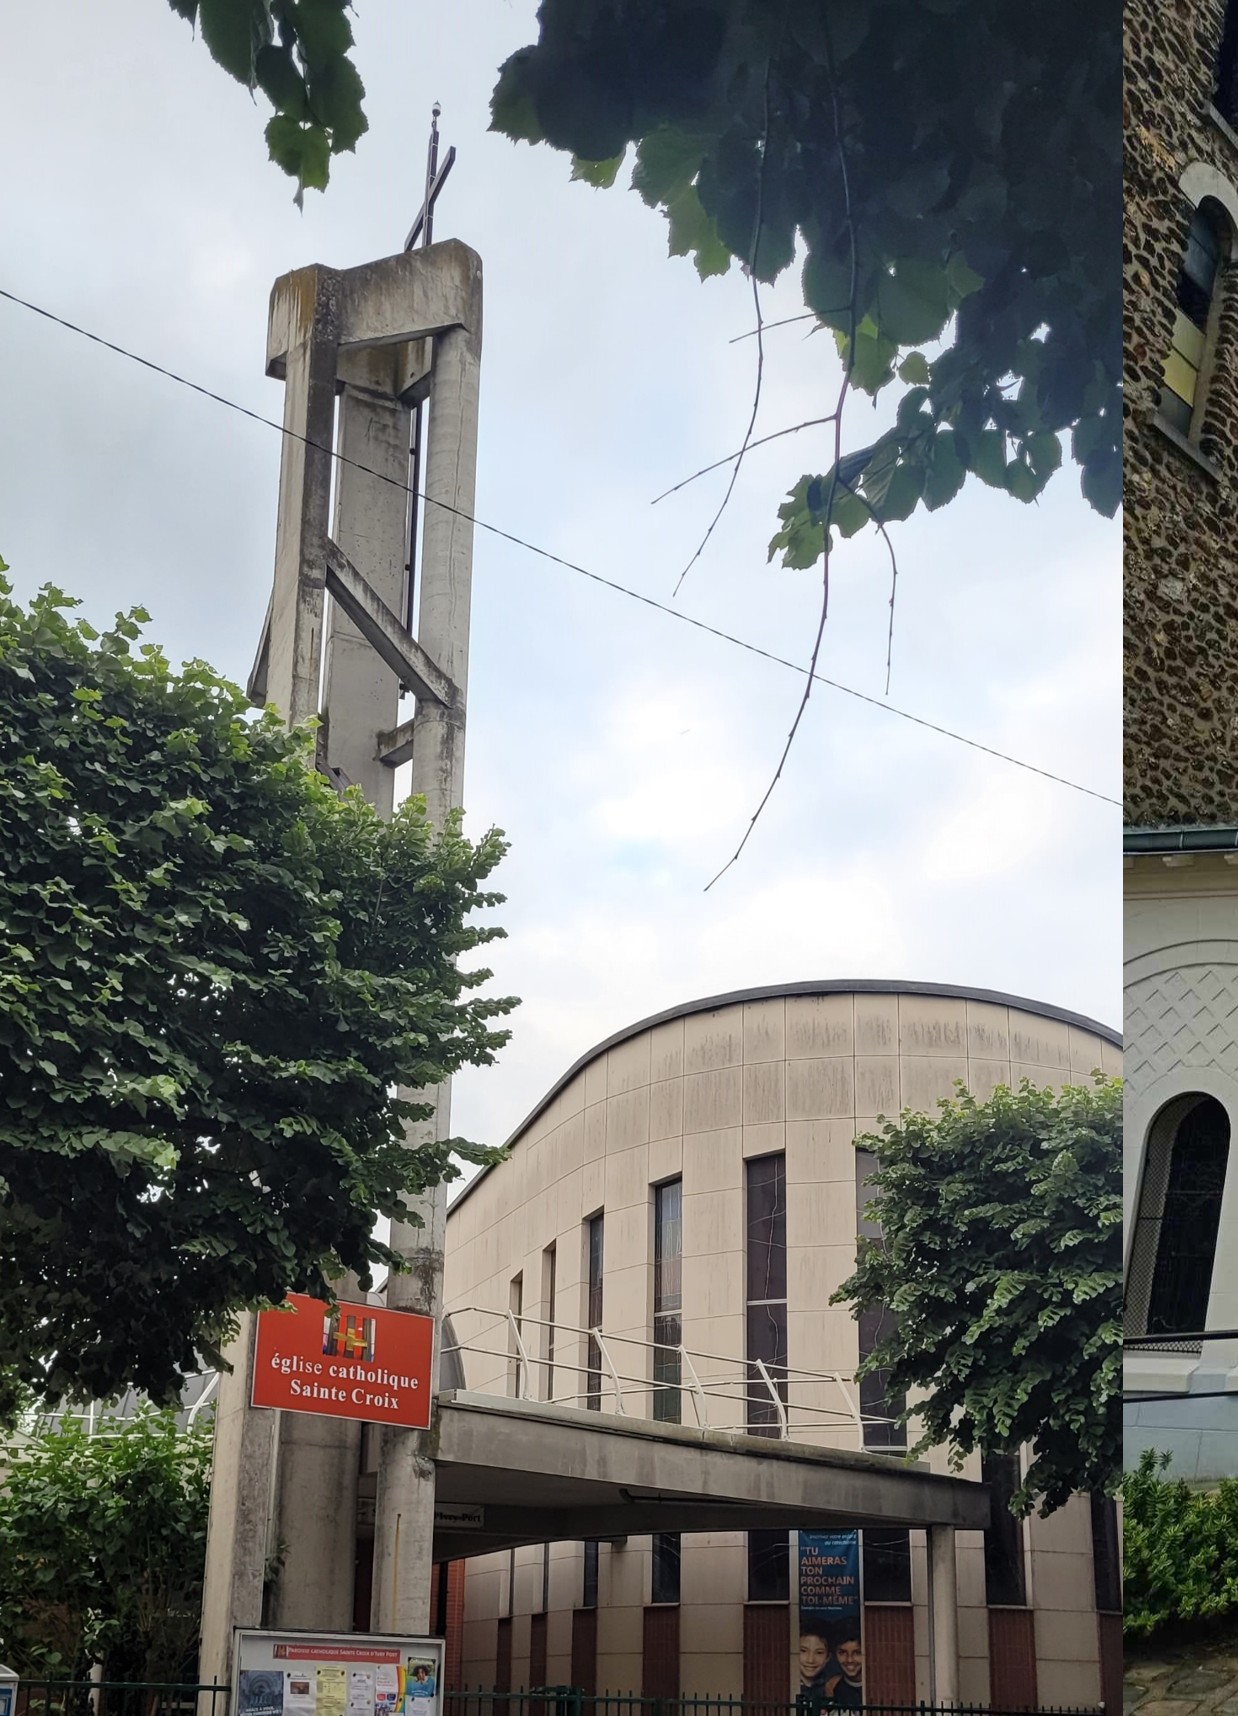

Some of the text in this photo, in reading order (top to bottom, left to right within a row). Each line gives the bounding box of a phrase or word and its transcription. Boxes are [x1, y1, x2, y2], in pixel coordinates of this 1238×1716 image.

[271, 1353, 418, 1390] église catholique
[290, 1379, 400, 1410] Sainte Croix
[801, 1556, 847, 1565] AIMERAS
[801, 1566, 823, 1575] TON
[800, 1576, 854, 1585] PROCHAIN
[801, 1586, 841, 1595] COMME
